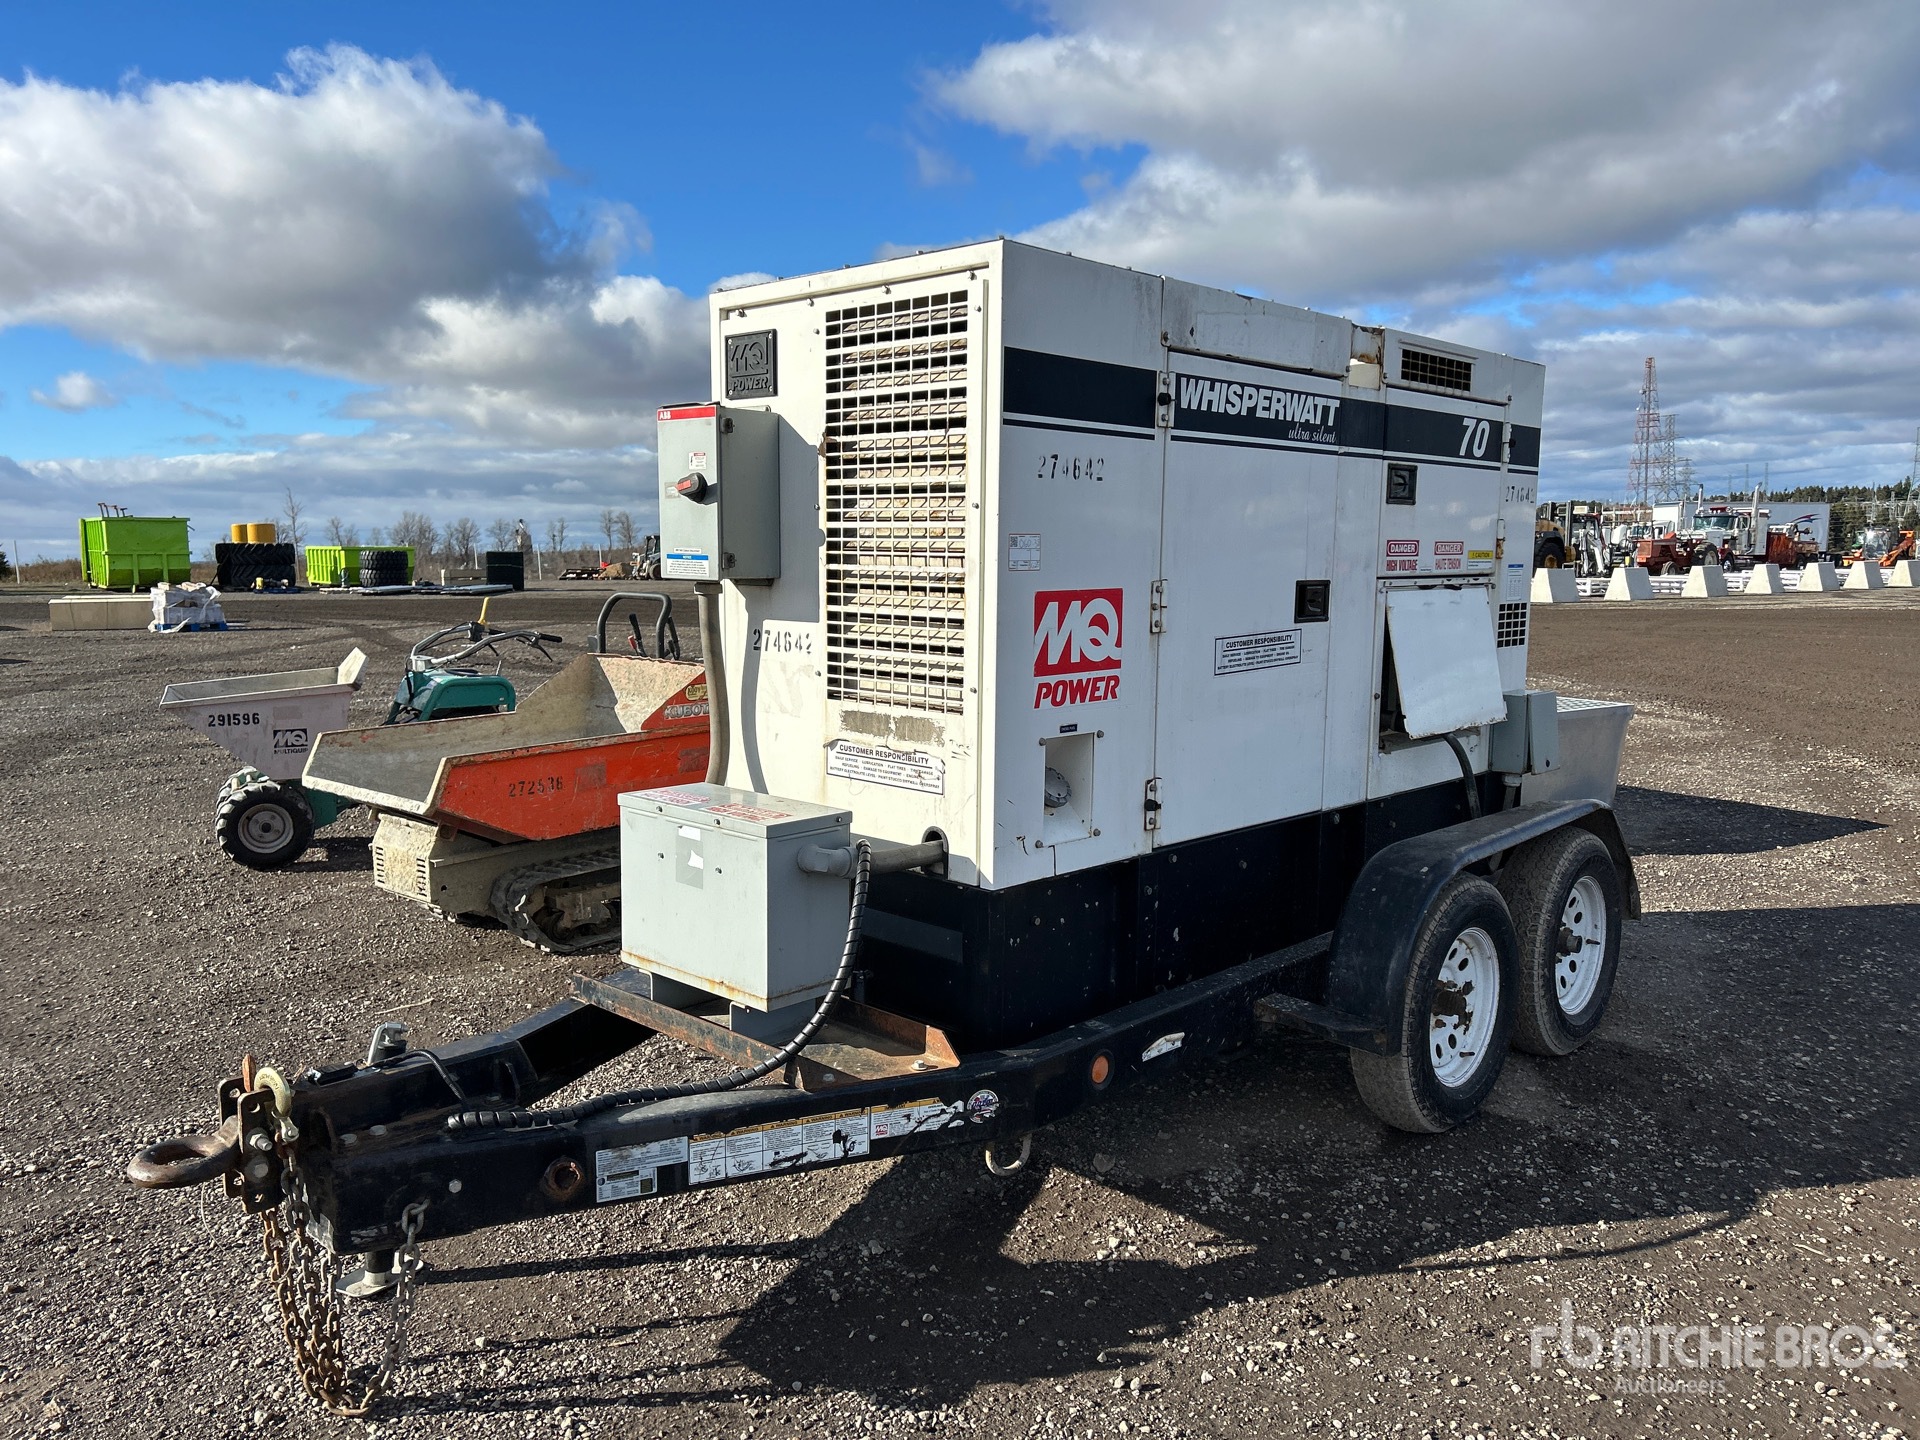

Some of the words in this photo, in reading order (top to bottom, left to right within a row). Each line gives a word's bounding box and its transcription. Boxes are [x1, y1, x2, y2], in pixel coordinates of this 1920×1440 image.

[730, 338, 767, 373] MQ
[731, 376, 769, 392] POWER
[1180, 377, 1340, 427] WHISPERWATT
[659, 410, 671, 420] ABB
[1288, 422, 1311, 441] ultra
[1311, 425, 1337, 444] silent
[1459, 417, 1490, 458] 70
[1037, 454, 1105, 482] 274642
[1390, 544, 1416, 553] DANGER
[1437, 544, 1461, 553] DANGER
[753, 628, 813, 655] 274642
[1034, 597, 1122, 666] MQ
[1225, 639, 1254, 649] CUSTOMER
[1254, 635, 1293, 646] RESPONSIBILITY
[1034, 675, 1120, 709] POWER
[208, 713, 260, 728] 291596
[664, 703, 709, 719] KUBOT
[274, 729, 308, 749] MQ
[839, 744, 874, 757] CUSTOMER
[875, 749, 930, 765] RESPONSIBILITY
